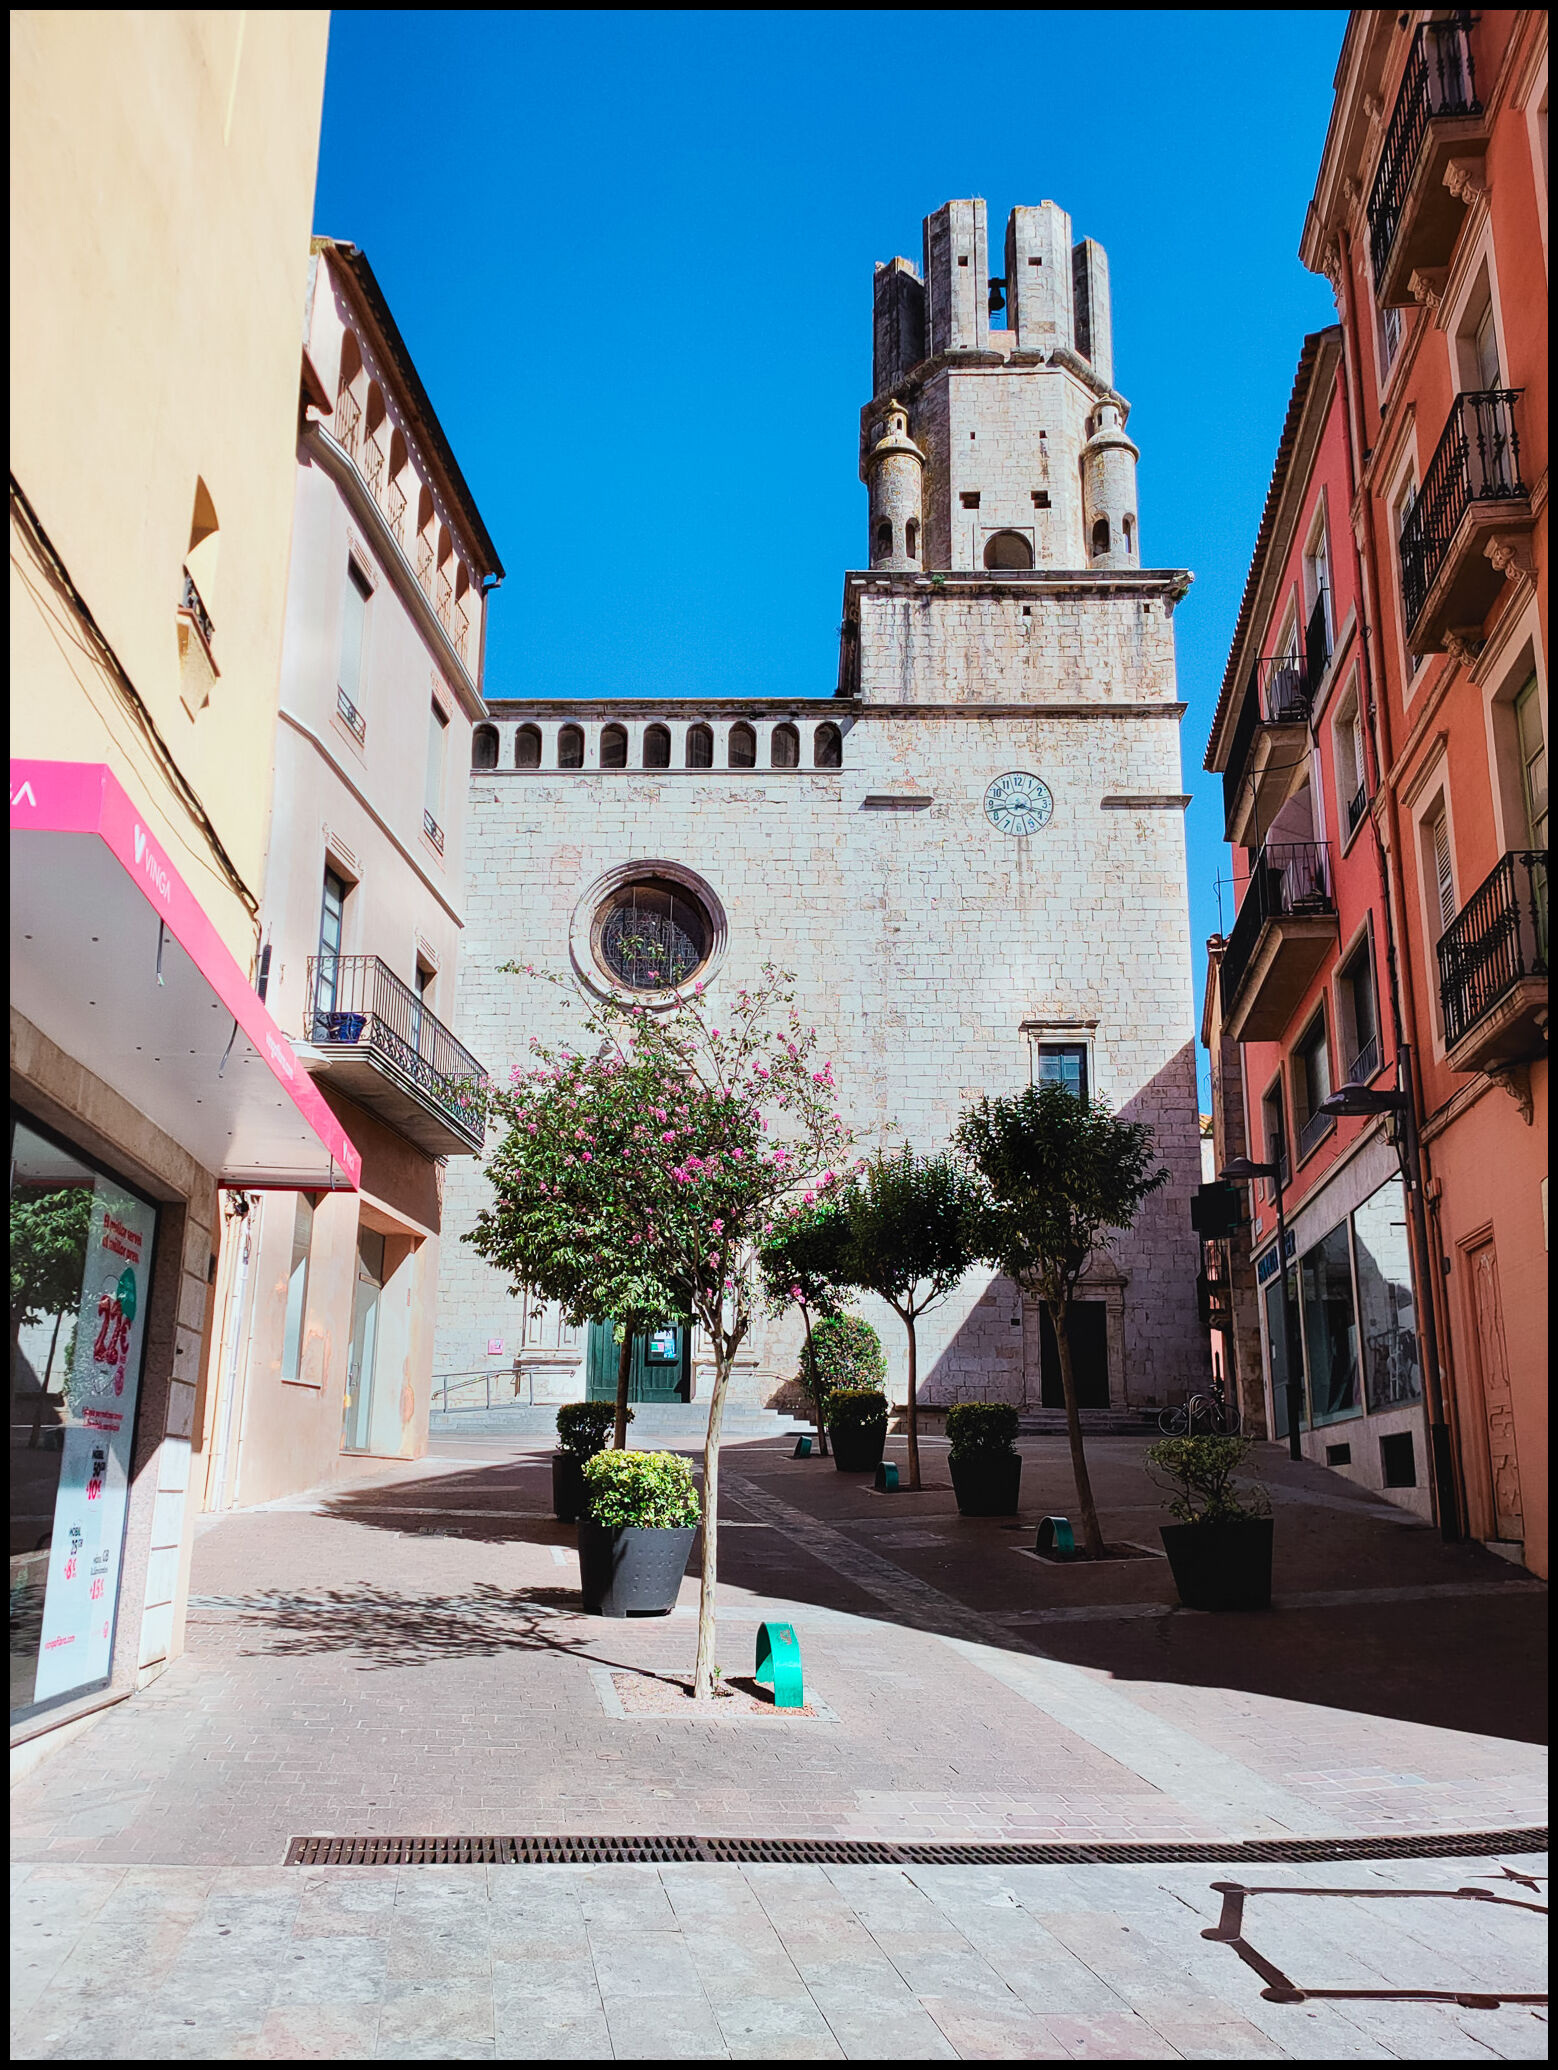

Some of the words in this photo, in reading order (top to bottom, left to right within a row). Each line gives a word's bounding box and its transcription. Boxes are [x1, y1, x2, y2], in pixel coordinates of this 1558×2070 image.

[1002, 780, 1010, 790] 11
[1013, 777, 1023, 787] 12
[992, 788, 1002, 798] 10
[1036, 787, 1043, 797] 2
[1042, 799, 1048, 809] 3
[1003, 819, 1011, 829] 7
